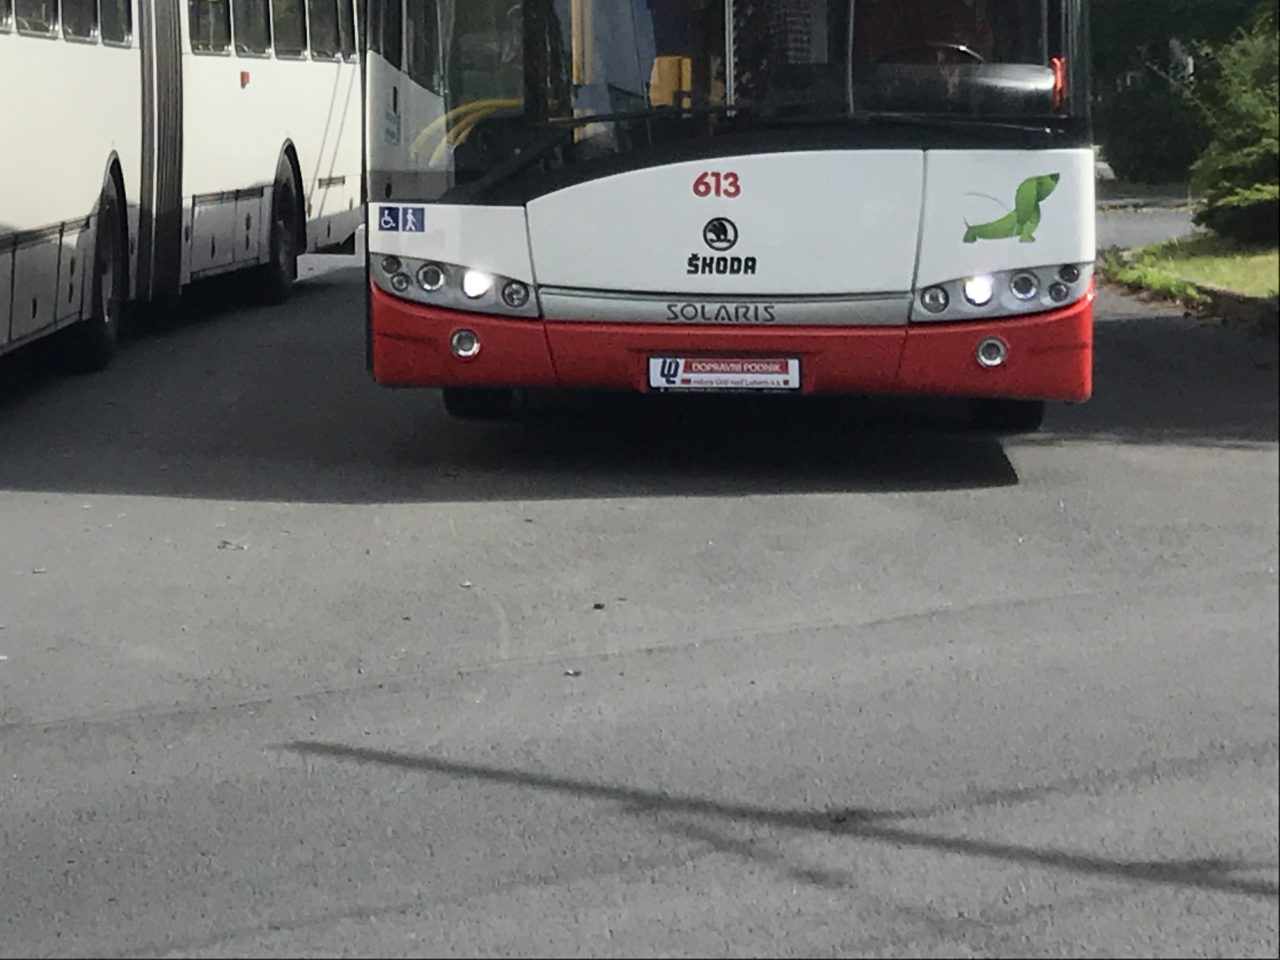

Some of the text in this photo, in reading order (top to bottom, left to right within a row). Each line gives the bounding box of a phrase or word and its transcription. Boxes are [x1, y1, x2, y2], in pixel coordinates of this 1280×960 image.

[693, 171, 741, 198] 613
[687, 253, 757, 275] ŠKODA
[666, 303, 776, 323] SOLARIS
